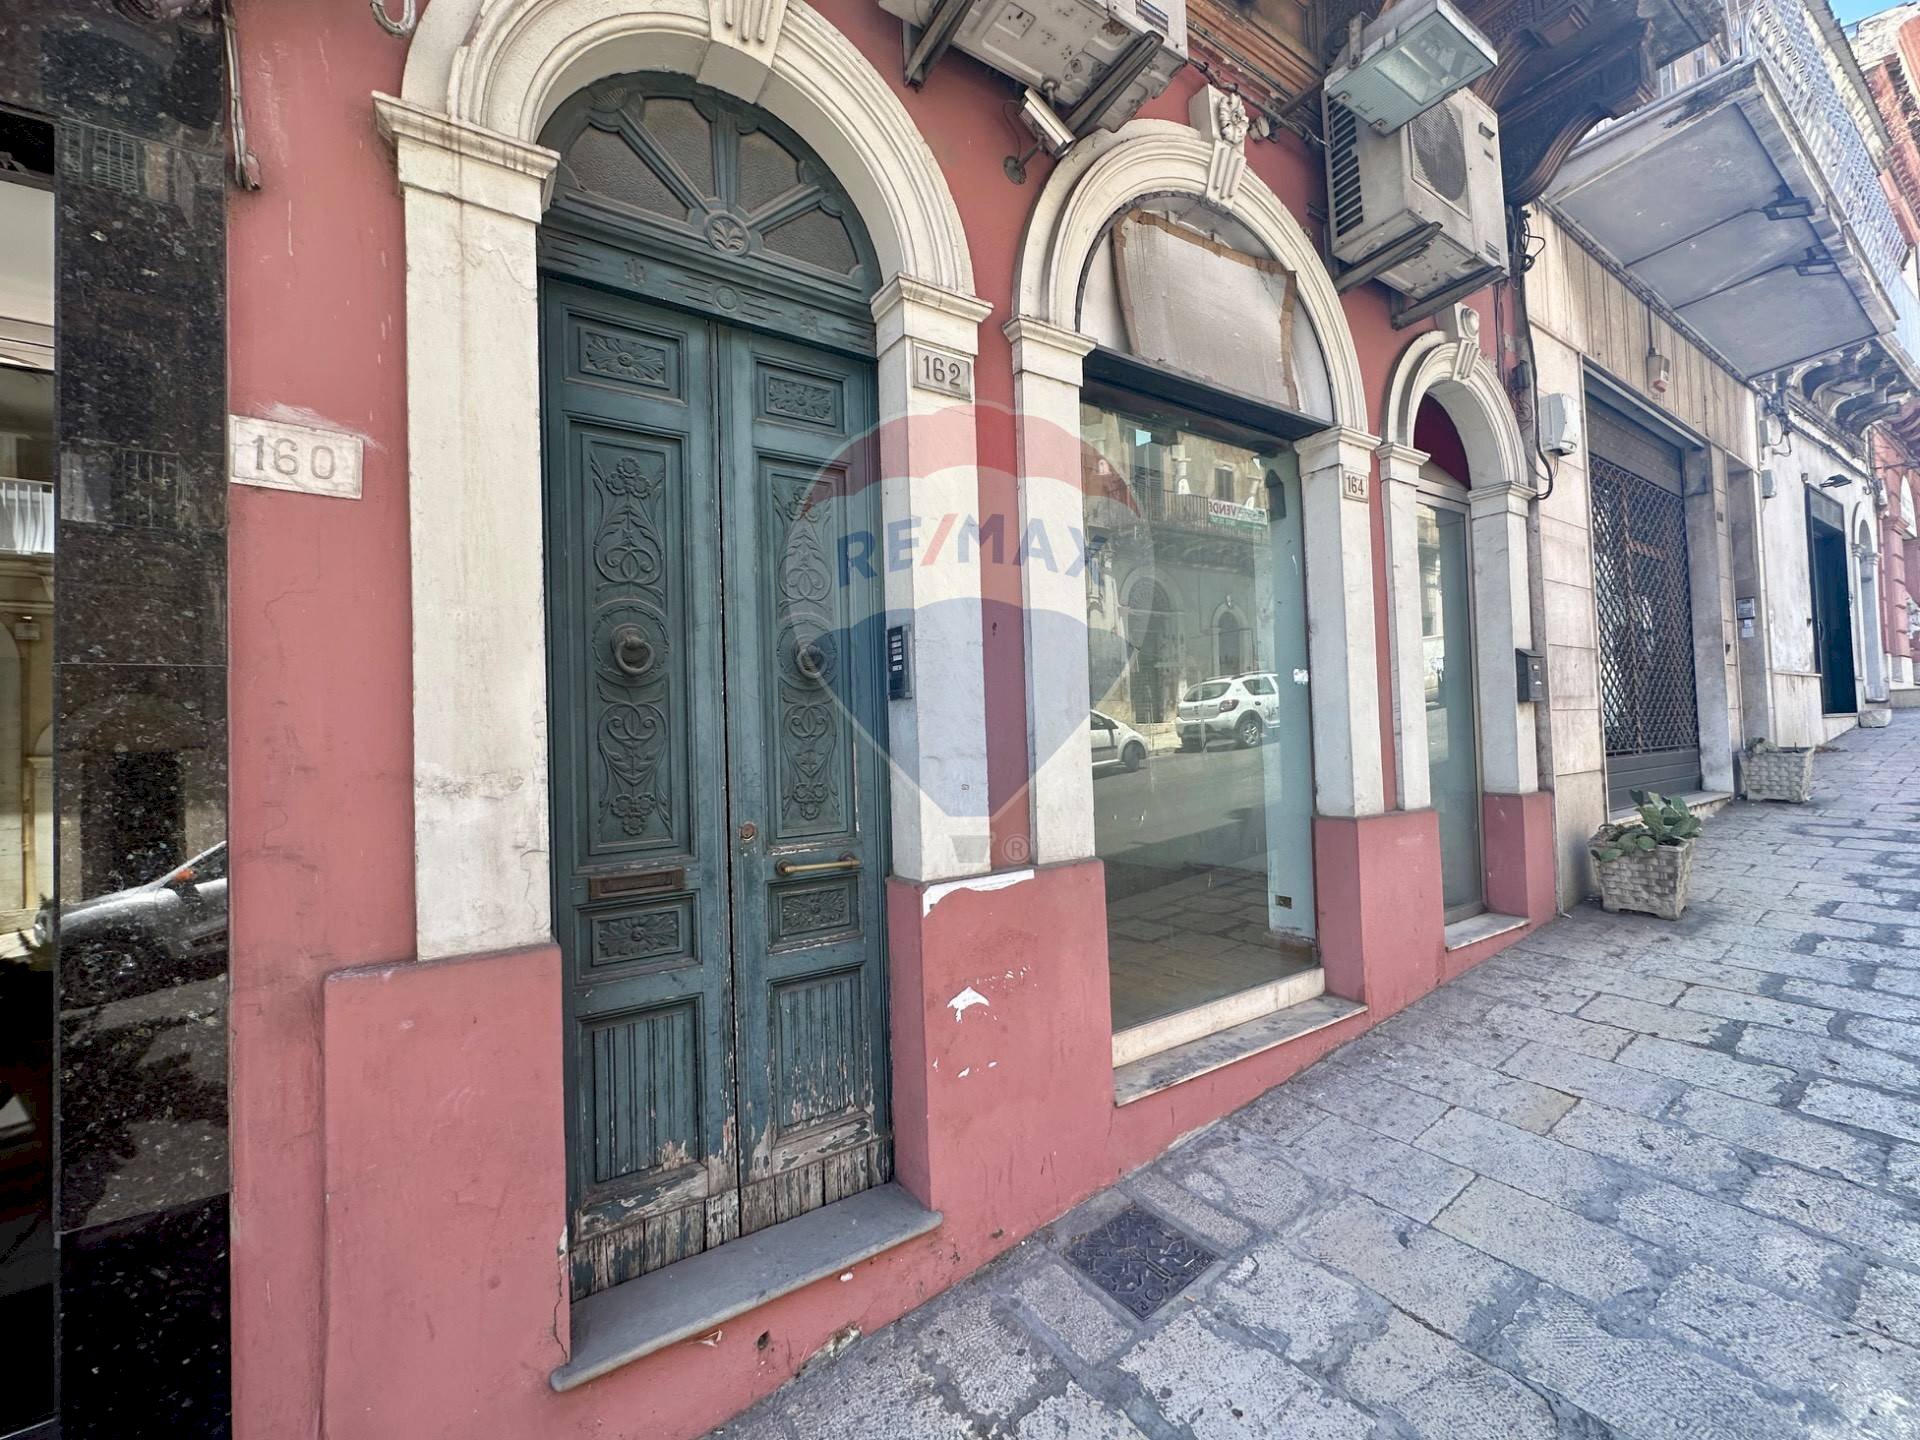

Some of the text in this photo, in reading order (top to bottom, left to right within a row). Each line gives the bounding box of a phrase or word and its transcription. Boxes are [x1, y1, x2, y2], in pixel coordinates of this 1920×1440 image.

[923, 355, 961, 387] 162
[251, 434, 336, 480] 160
[1345, 474, 1365, 496] 164
